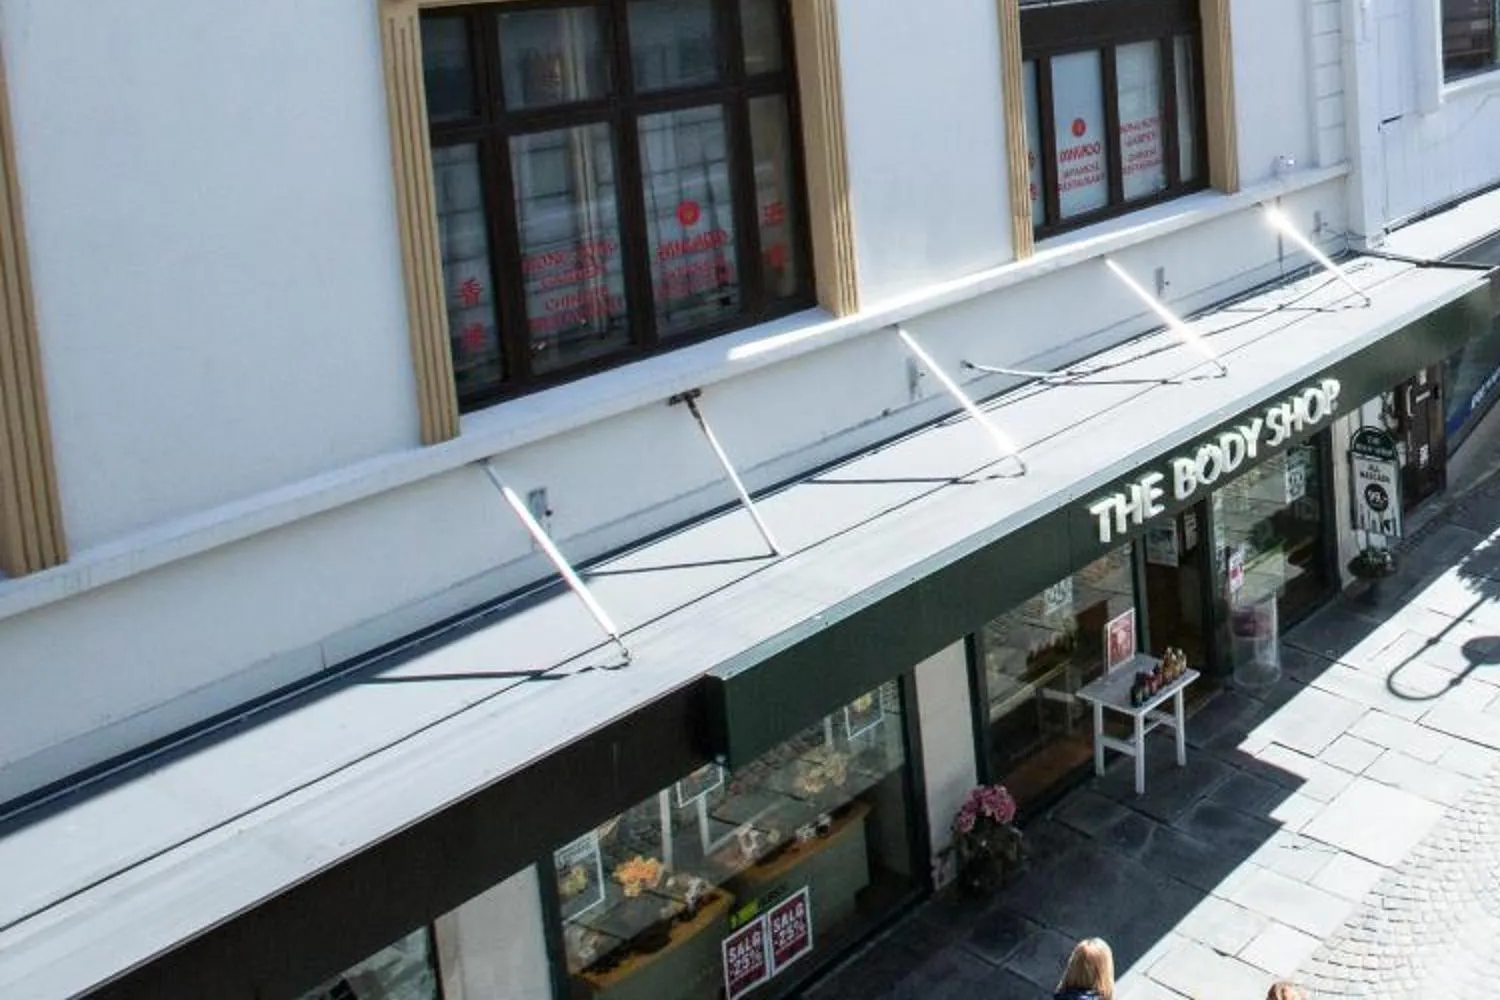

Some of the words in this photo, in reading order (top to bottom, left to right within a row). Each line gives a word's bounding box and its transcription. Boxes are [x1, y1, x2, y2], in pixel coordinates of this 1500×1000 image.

[1089, 472, 1165, 544] THE
[1171, 417, 1264, 500] BODY
[1265, 379, 1341, 447] SHOP
[773, 902, 805, 934] SALG
[728, 931, 761, 964] SALG
